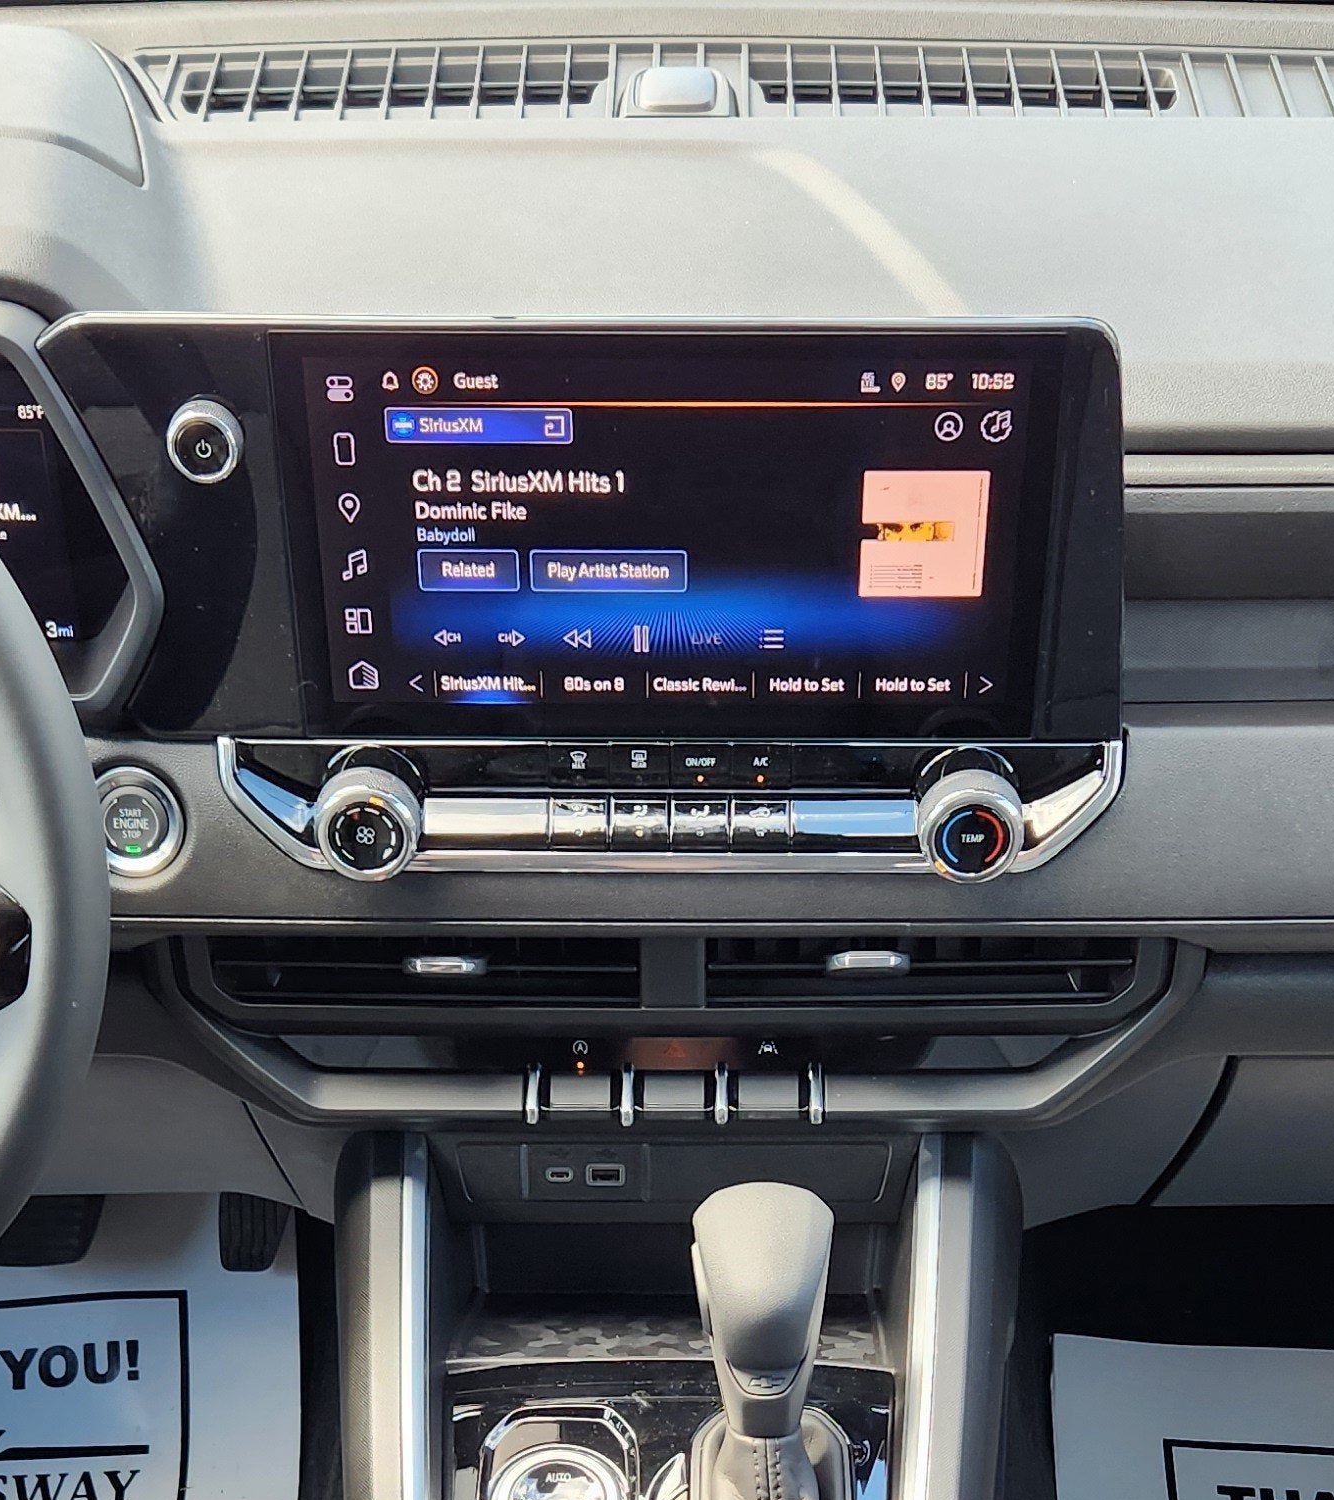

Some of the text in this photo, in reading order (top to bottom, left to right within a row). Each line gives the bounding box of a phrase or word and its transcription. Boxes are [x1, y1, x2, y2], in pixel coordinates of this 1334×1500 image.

[453, 372, 498, 390] Guest
[925, 373, 954, 390] 85°
[419, 417, 483, 433] SiriusXM
[412, 470, 625, 493] Ch 2 SiriusXM Hits 1
[415, 502, 528, 521] Dominic Fike
[417, 527, 475, 545] Babydoll
[441, 562, 495, 578] Related
[547, 563, 670, 581] Play Artist Station
[691, 632, 721, 645] LIVE
[440, 677, 500, 692] SiriusXM
[593, 680, 610, 692] on
[653, 677, 699, 692] Classic
[769, 677, 844, 692] Hold to Set
[875, 677, 950, 692] Hold to Set
[685, 757, 716, 767] ON/OFF
[753, 756, 769, 767] A/C
[119, 808, 142, 818] START
[113, 818, 149, 830] ENGINE
[122, 830, 142, 839] STOP
[961, 833, 985, 843] TEMP
[545, 1472, 572, 1483] AUTO
